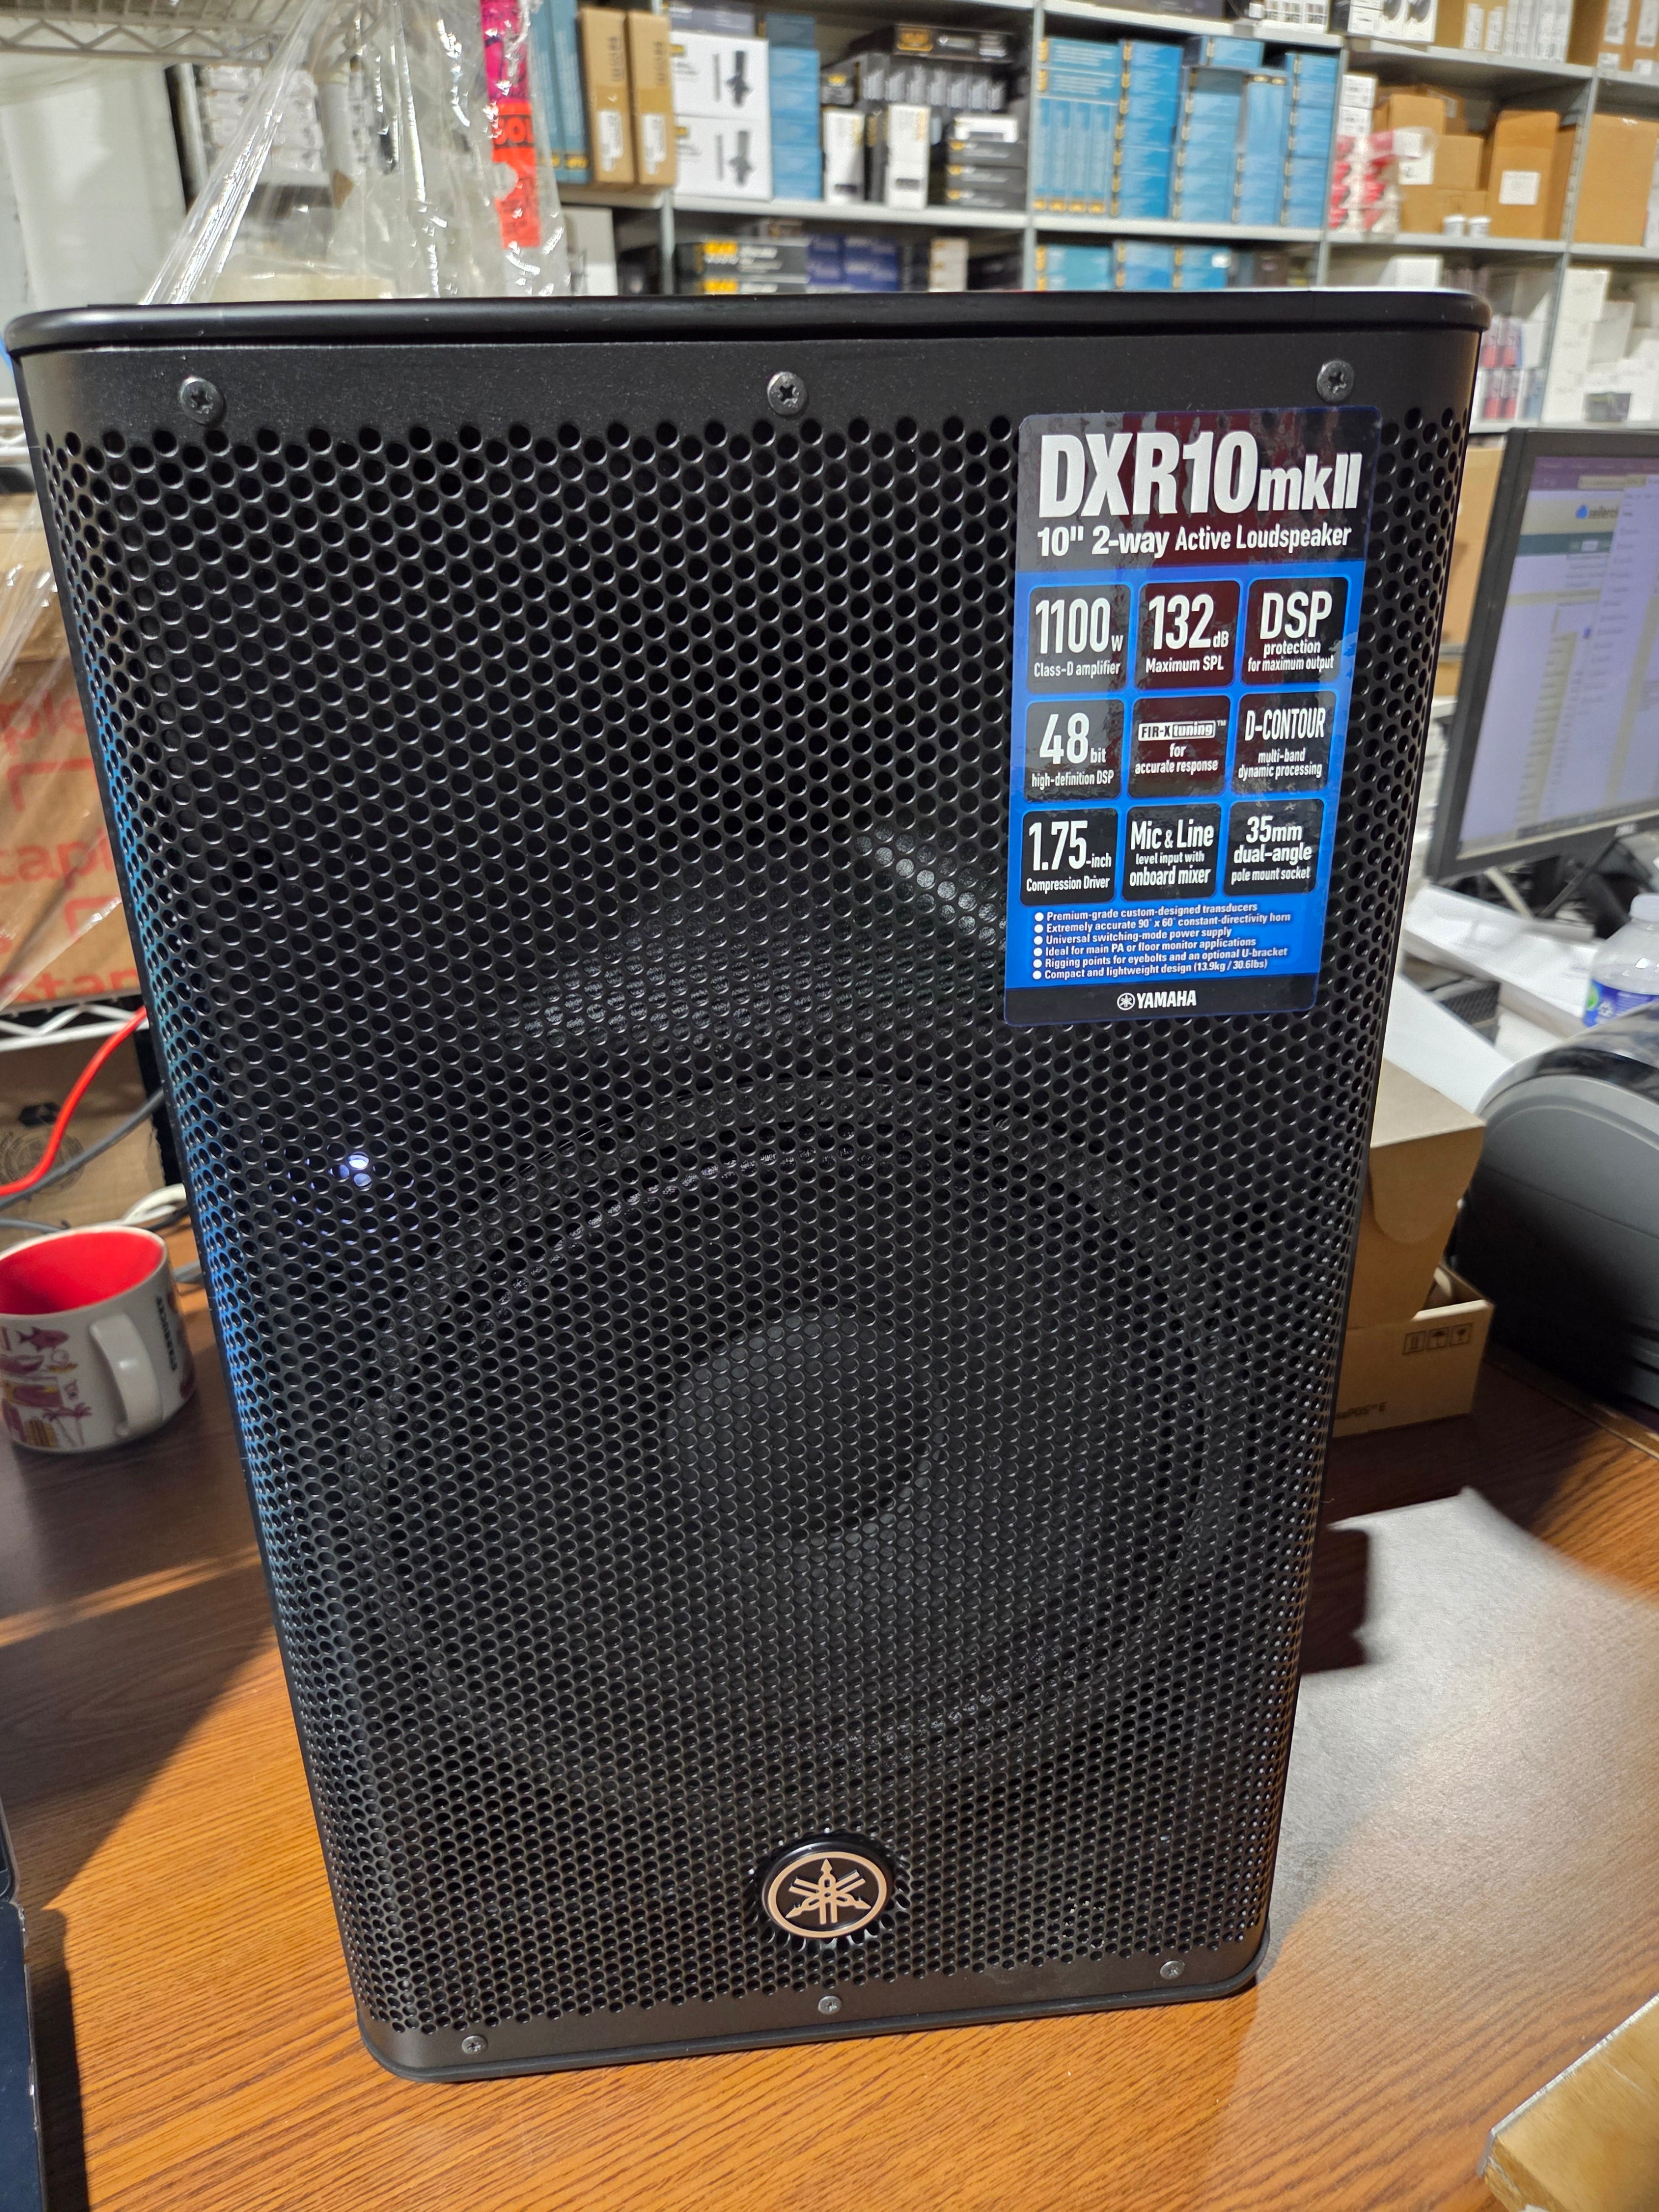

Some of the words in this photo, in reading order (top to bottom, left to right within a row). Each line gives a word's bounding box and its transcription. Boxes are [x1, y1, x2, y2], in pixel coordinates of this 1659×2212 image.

[1037, 524, 1083, 556] 10"
[1092, 525, 1170, 558] 2-way
[1175, 524, 1230, 551] Active
[1236, 523, 1352, 552] Loudspeaker
[1260, 591, 1332, 639] DSP
[1264, 640, 1321, 659] protection
[1034, 663, 1074, 677] Class-D
[1075, 662, 1121, 678] amplifier
[1146, 656, 1200, 673] Maximum
[1203, 655, 1224, 671] SPL
[1248, 658, 1260, 671] for
[1262, 658, 1305, 671] maximum
[1306, 657, 1334, 671] output
[1245, 707, 1326, 741] D-CONTOUR
[1170, 743, 1187, 758] for
[1258, 748, 1306, 763] multi-band
[1135, 760, 1175, 775] accurate
[1176, 760, 1218, 775] response
[1238, 765, 1274, 781] dynamic
[1275, 764, 1322, 780] processing
[1032, 772, 1094, 790] high-definition
[1097, 770, 1114, 784] DSP
[1130, 821, 1162, 851] Mic
[1165, 831, 1173, 848] &
[1177, 819, 1214, 848] Line
[1136, 853, 1157, 865] level
[1160, 852, 1183, 865] input
[1185, 851, 1204, 863] with
[1234, 843, 1312, 866] dual-angle
[1129, 867, 1176, 886] onboard
[1178, 865, 1211, 884] mixer
[1232, 870, 1250, 885] pole
[1252, 868, 1280, 881] mount
[1281, 867, 1310, 880] socket
[1026, 877, 1082, 894] Compression
[1083, 876, 1110, 889] Driver
[1047, 909, 1119, 921] Premium-grade
[1121, 905, 1201, 917] custom-designed
[1203, 904, 1258, 913] transducers
[1046, 921, 1093, 933] Extremely
[1095, 921, 1136, 930] accurate
[1178, 914, 1267, 926] constant-directivity
[1270, 913, 1291, 921] horn
[1046, 933, 1090, 945] Universal
[1093, 930, 1167, 942] switching-mode
[1170, 930, 1199, 940] power
[1201, 927, 1232, 938] supply
[1045, 946, 1068, 956] Ideal
[1071, 945, 1083, 954] for
[1086, 945, 1109, 954] main
[1112, 943, 1124, 953] PA
[1138, 942, 1160, 951] floor
[1162, 941, 1198, 951] monitor
[1199, 938, 1256, 950] applications
[1045, 958, 1080, 969] Rigging
[1082, 957, 1111, 968] points
[1113, 955, 1125, 964] for
[1128, 953, 1167, 966] eyebolts
[1169, 952, 1187, 962] and
[1202, 949, 1240, 962] optional
[1241, 947, 1288, 958] U-bracket
[1045, 969, 1085, 980] Compact
[1087, 967, 1104, 977] and
[1107, 964, 1159, 977] lightweight
[1161, 963, 1192, 974] design
[1193, 962, 1226, 973] (13.9kg
[1136, 990, 1197, 1009] YAMAHA
